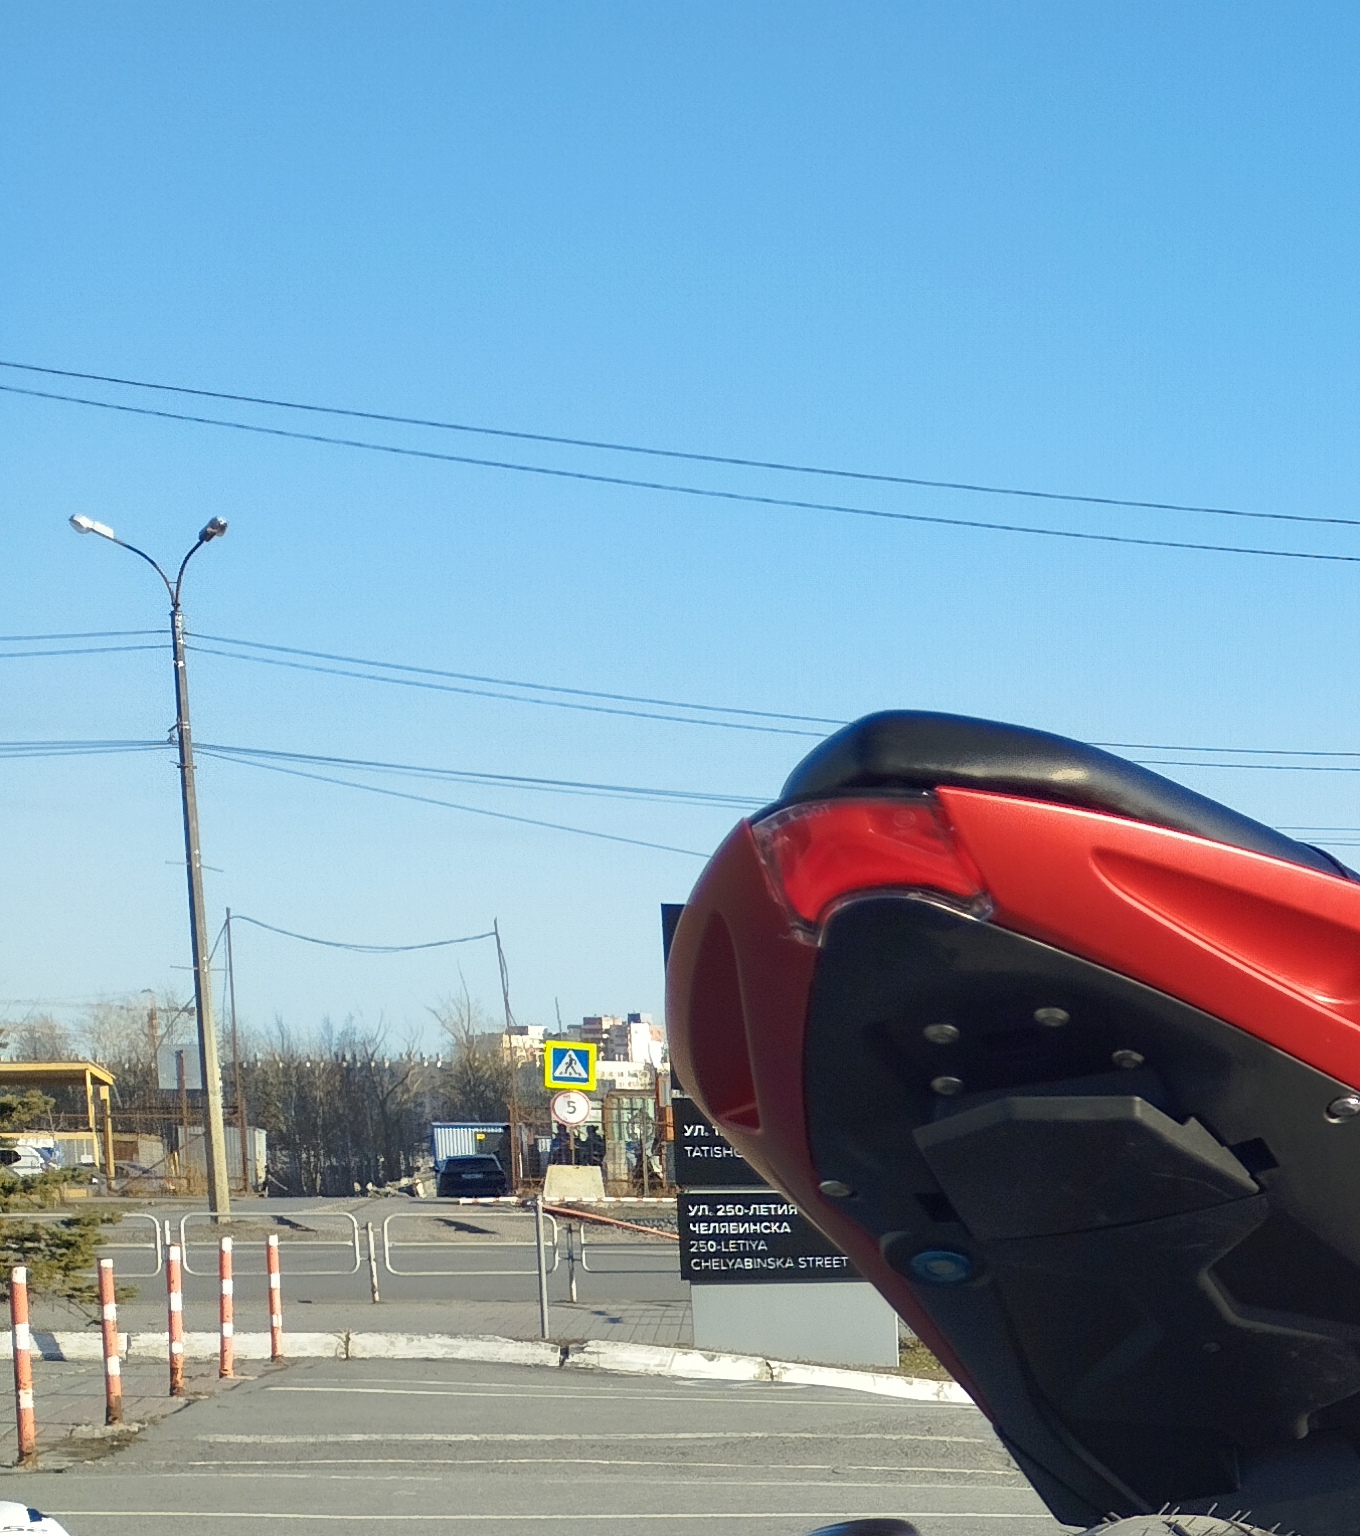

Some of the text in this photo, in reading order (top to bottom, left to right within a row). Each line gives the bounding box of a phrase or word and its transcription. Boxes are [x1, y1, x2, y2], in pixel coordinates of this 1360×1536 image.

[566, 1100, 577, 1115] 5
[683, 1124, 709, 1137] УЛ.
[688, 1203, 798, 1216] УЛ. 250-ЛЕТИЯ
[689, 1222, 792, 1234] ЧЕЛЯБИНСКА
[689, 1240, 768, 1253] 250-LETIYA
[690, 1256, 849, 1271] CHELYABINSKA STREET
